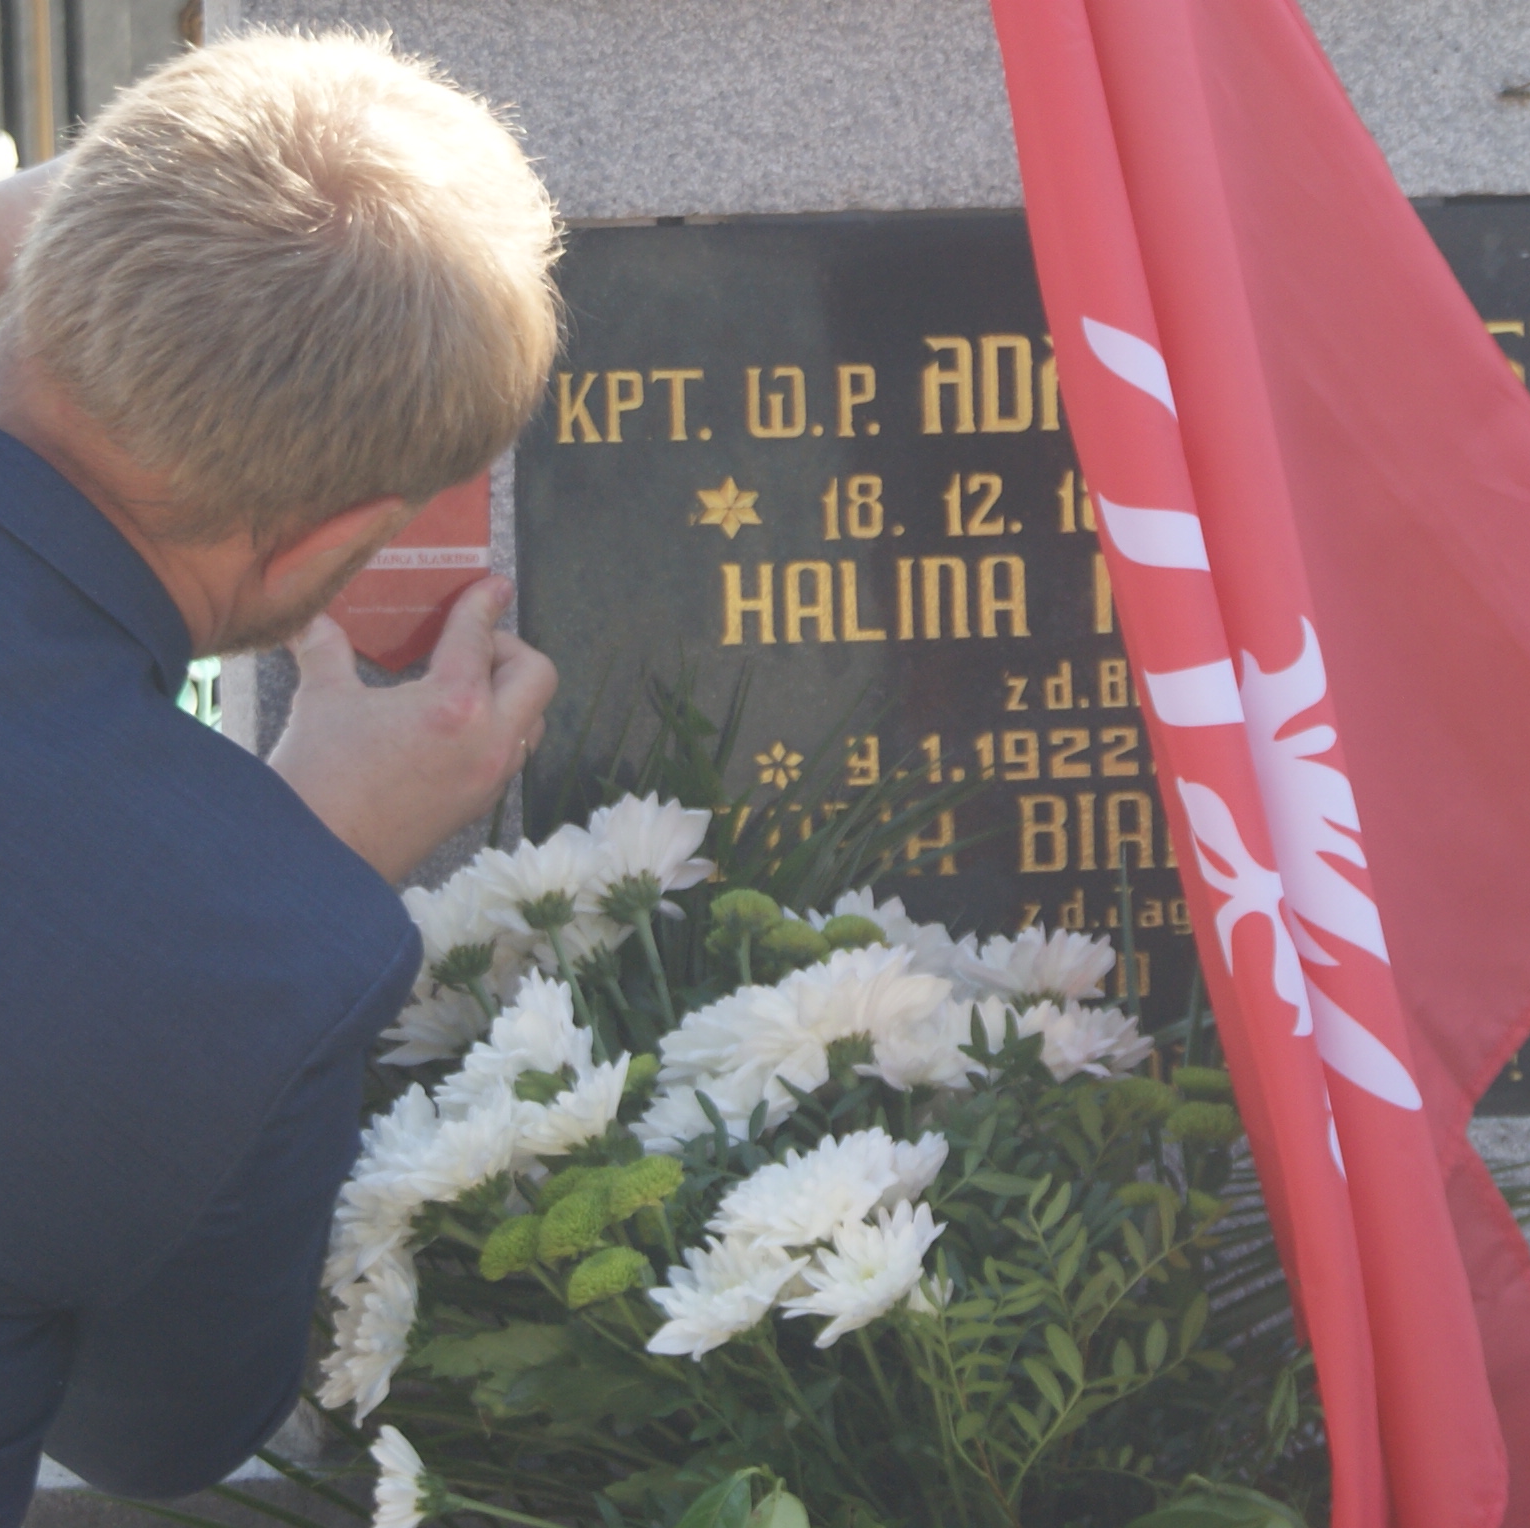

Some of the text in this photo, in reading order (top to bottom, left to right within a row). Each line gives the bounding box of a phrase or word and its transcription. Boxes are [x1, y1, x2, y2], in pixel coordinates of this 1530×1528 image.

[558, 368, 711, 443] KPT.
[822, 474, 903, 540] 18.
[943, 473, 1021, 536] 12.
[721, 555, 1028, 645] HALINA
